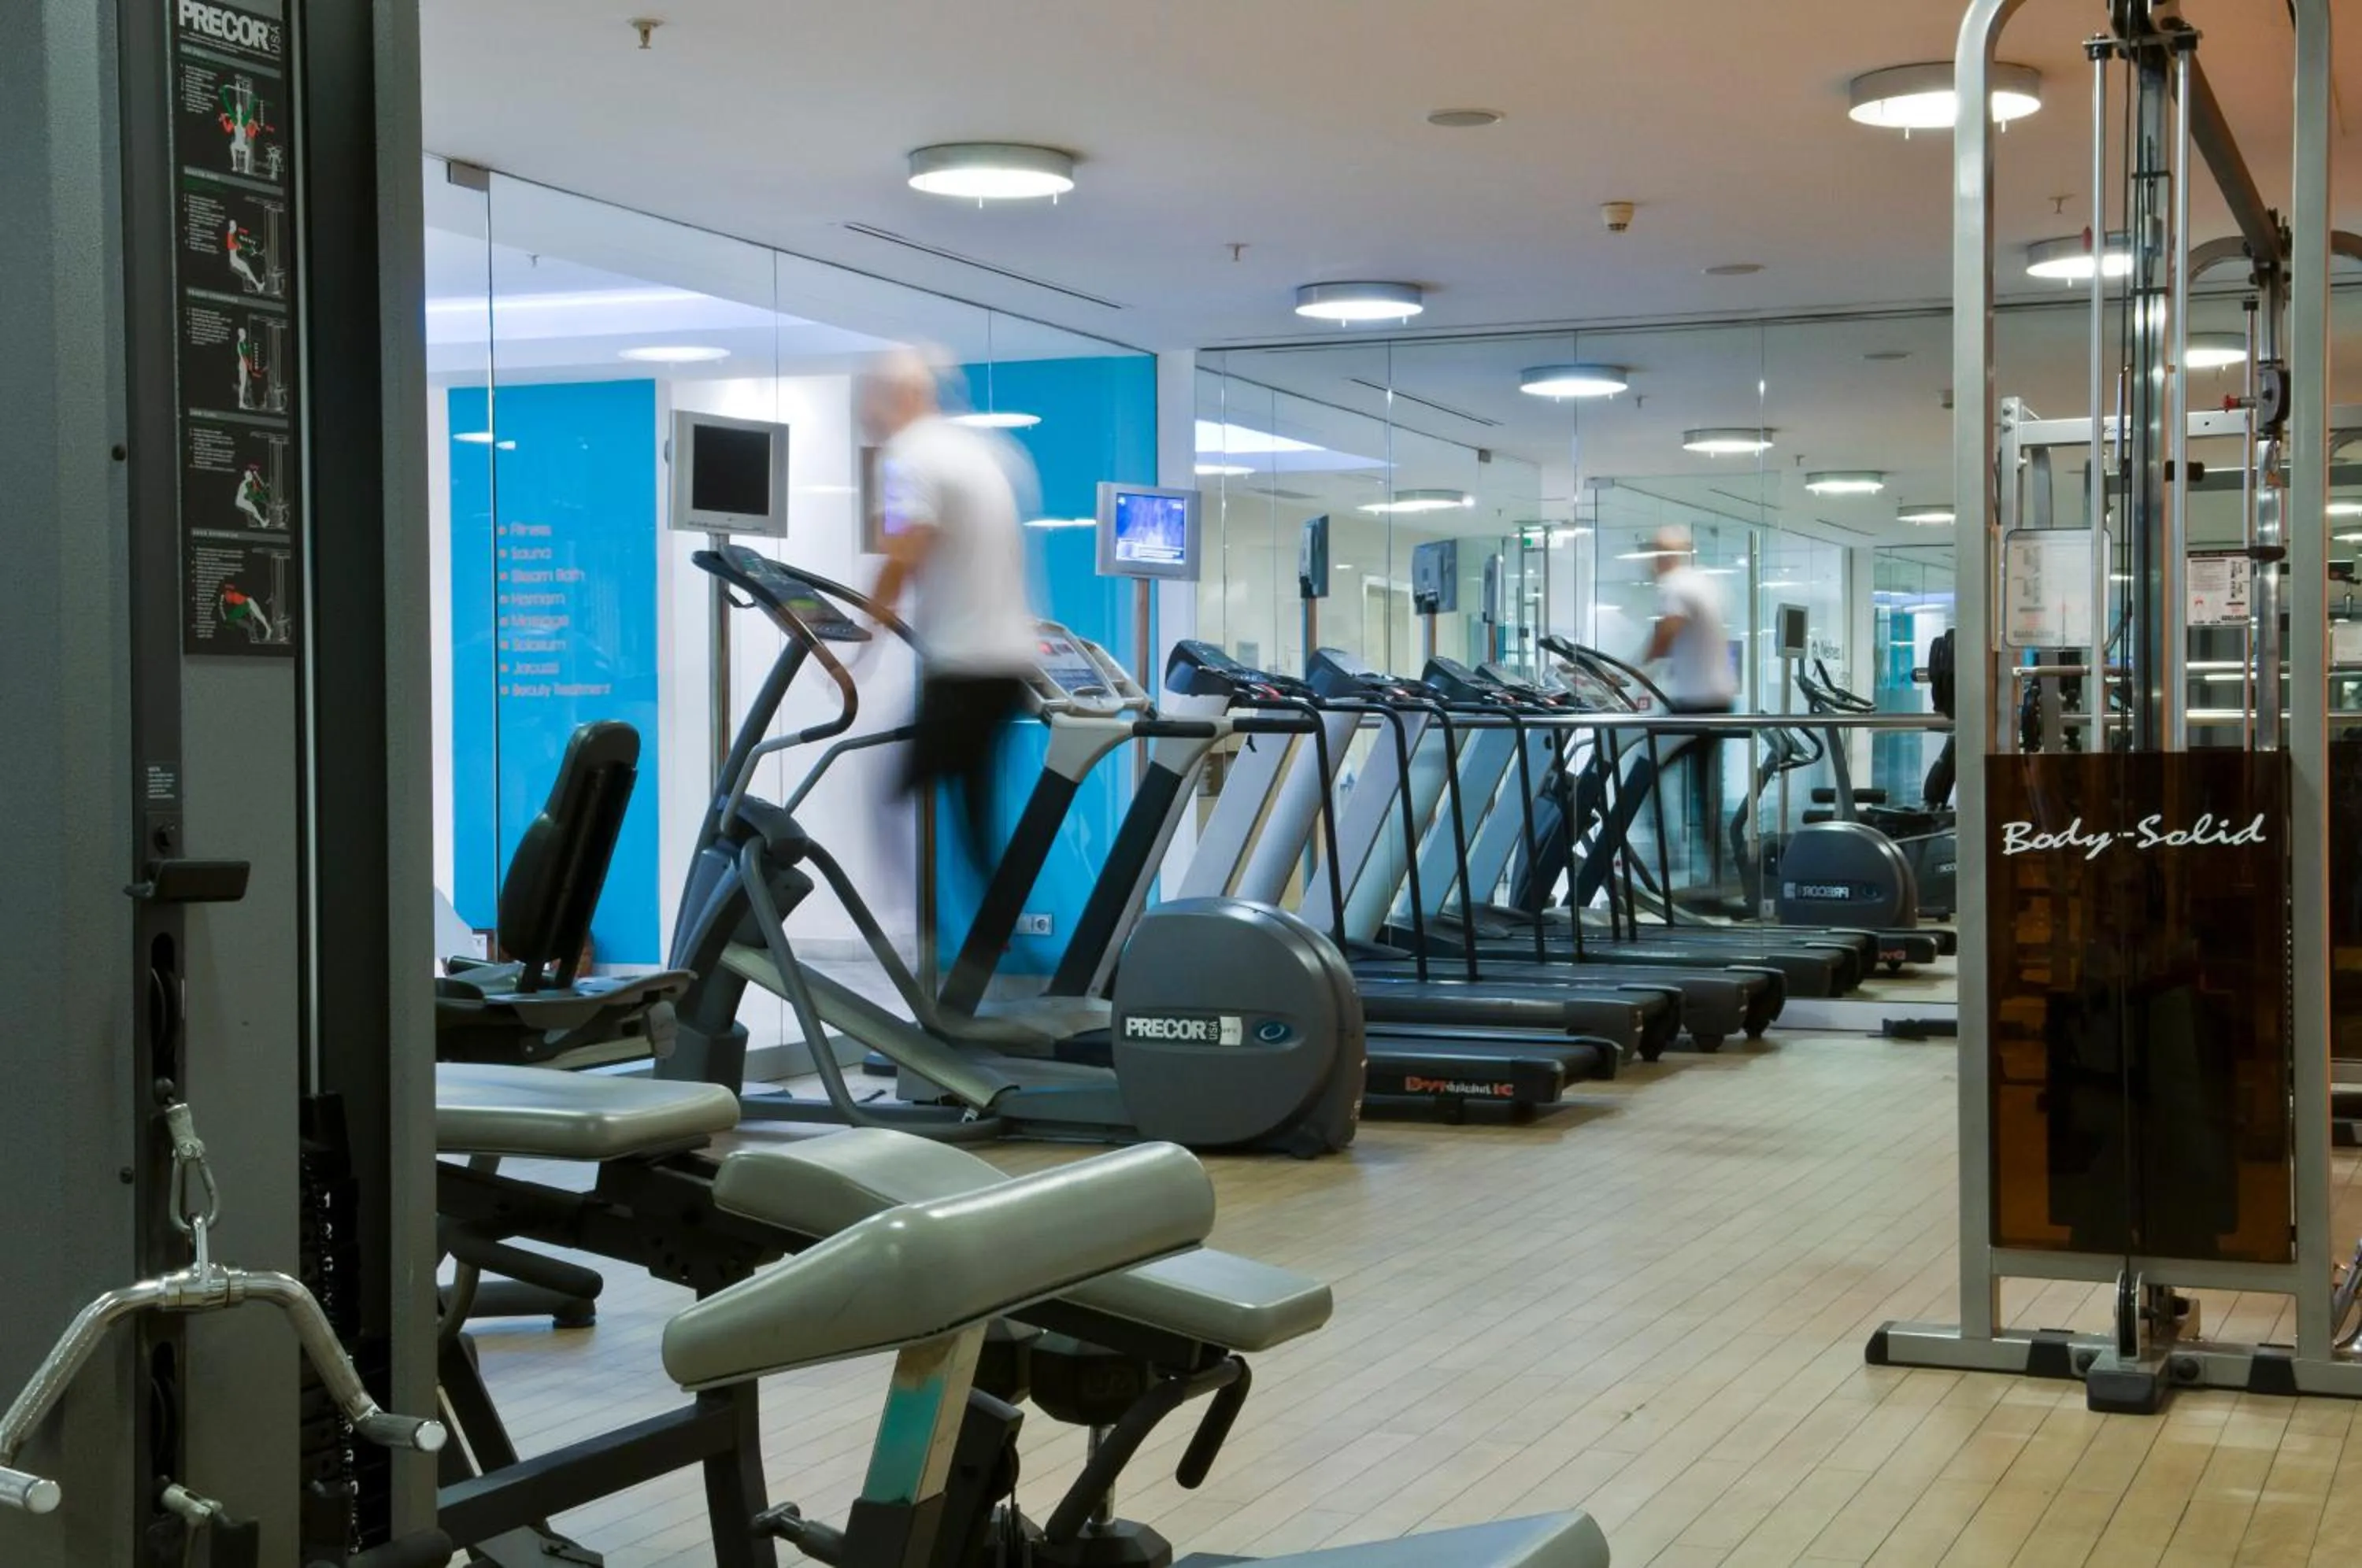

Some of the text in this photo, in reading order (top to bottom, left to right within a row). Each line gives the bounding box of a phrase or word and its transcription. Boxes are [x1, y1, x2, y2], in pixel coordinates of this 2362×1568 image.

[179, 0, 270, 51] PRECOR
[269, 26, 281, 53] USA
[2001, 812, 2267, 861] Body-Solid
[1125, 1016, 1218, 1041] PRECOR USA
